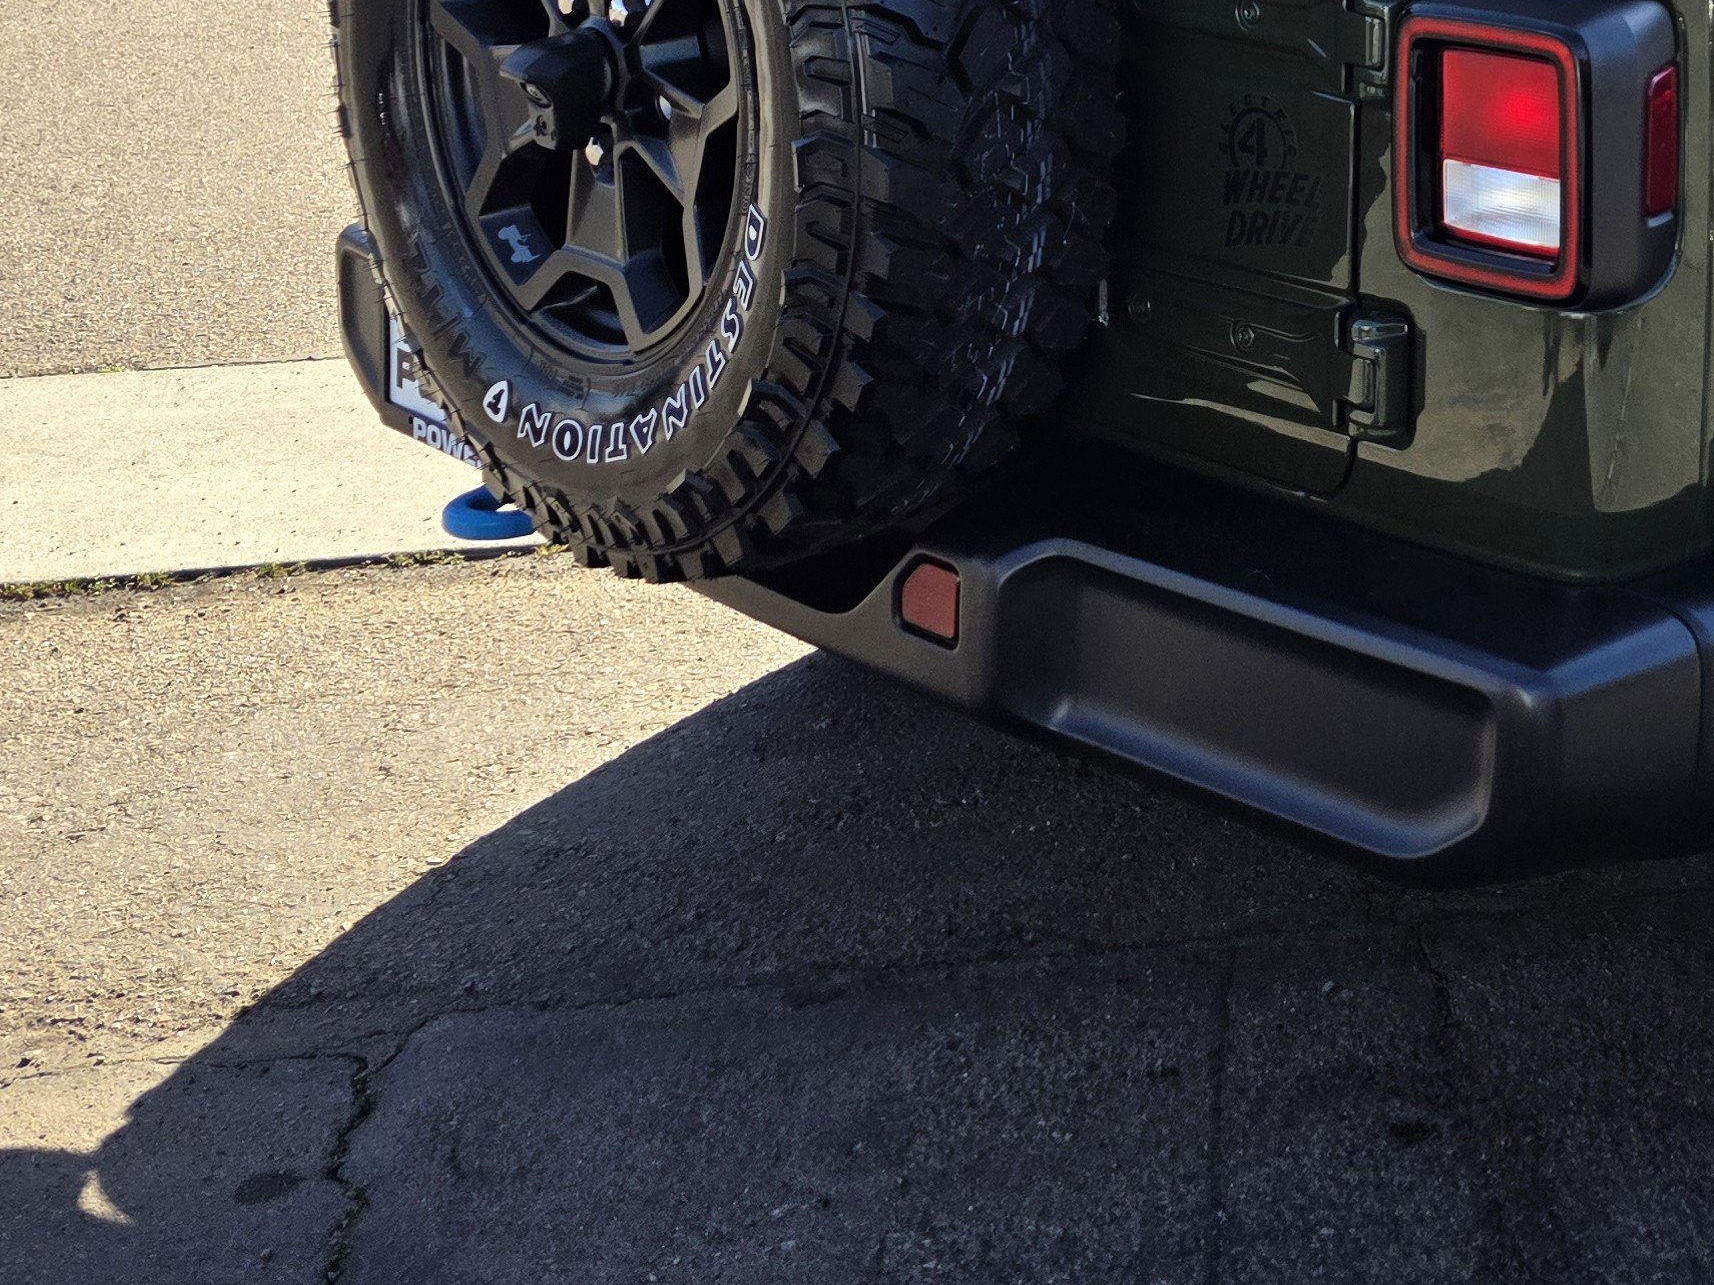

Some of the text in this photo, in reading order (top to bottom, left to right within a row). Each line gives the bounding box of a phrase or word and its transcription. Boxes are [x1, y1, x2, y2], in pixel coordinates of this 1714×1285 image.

[1223, 169, 1322, 210] WHEEL
[1224, 209, 1319, 247] DRIVE
[517, 204, 766, 464] DESTINATION
